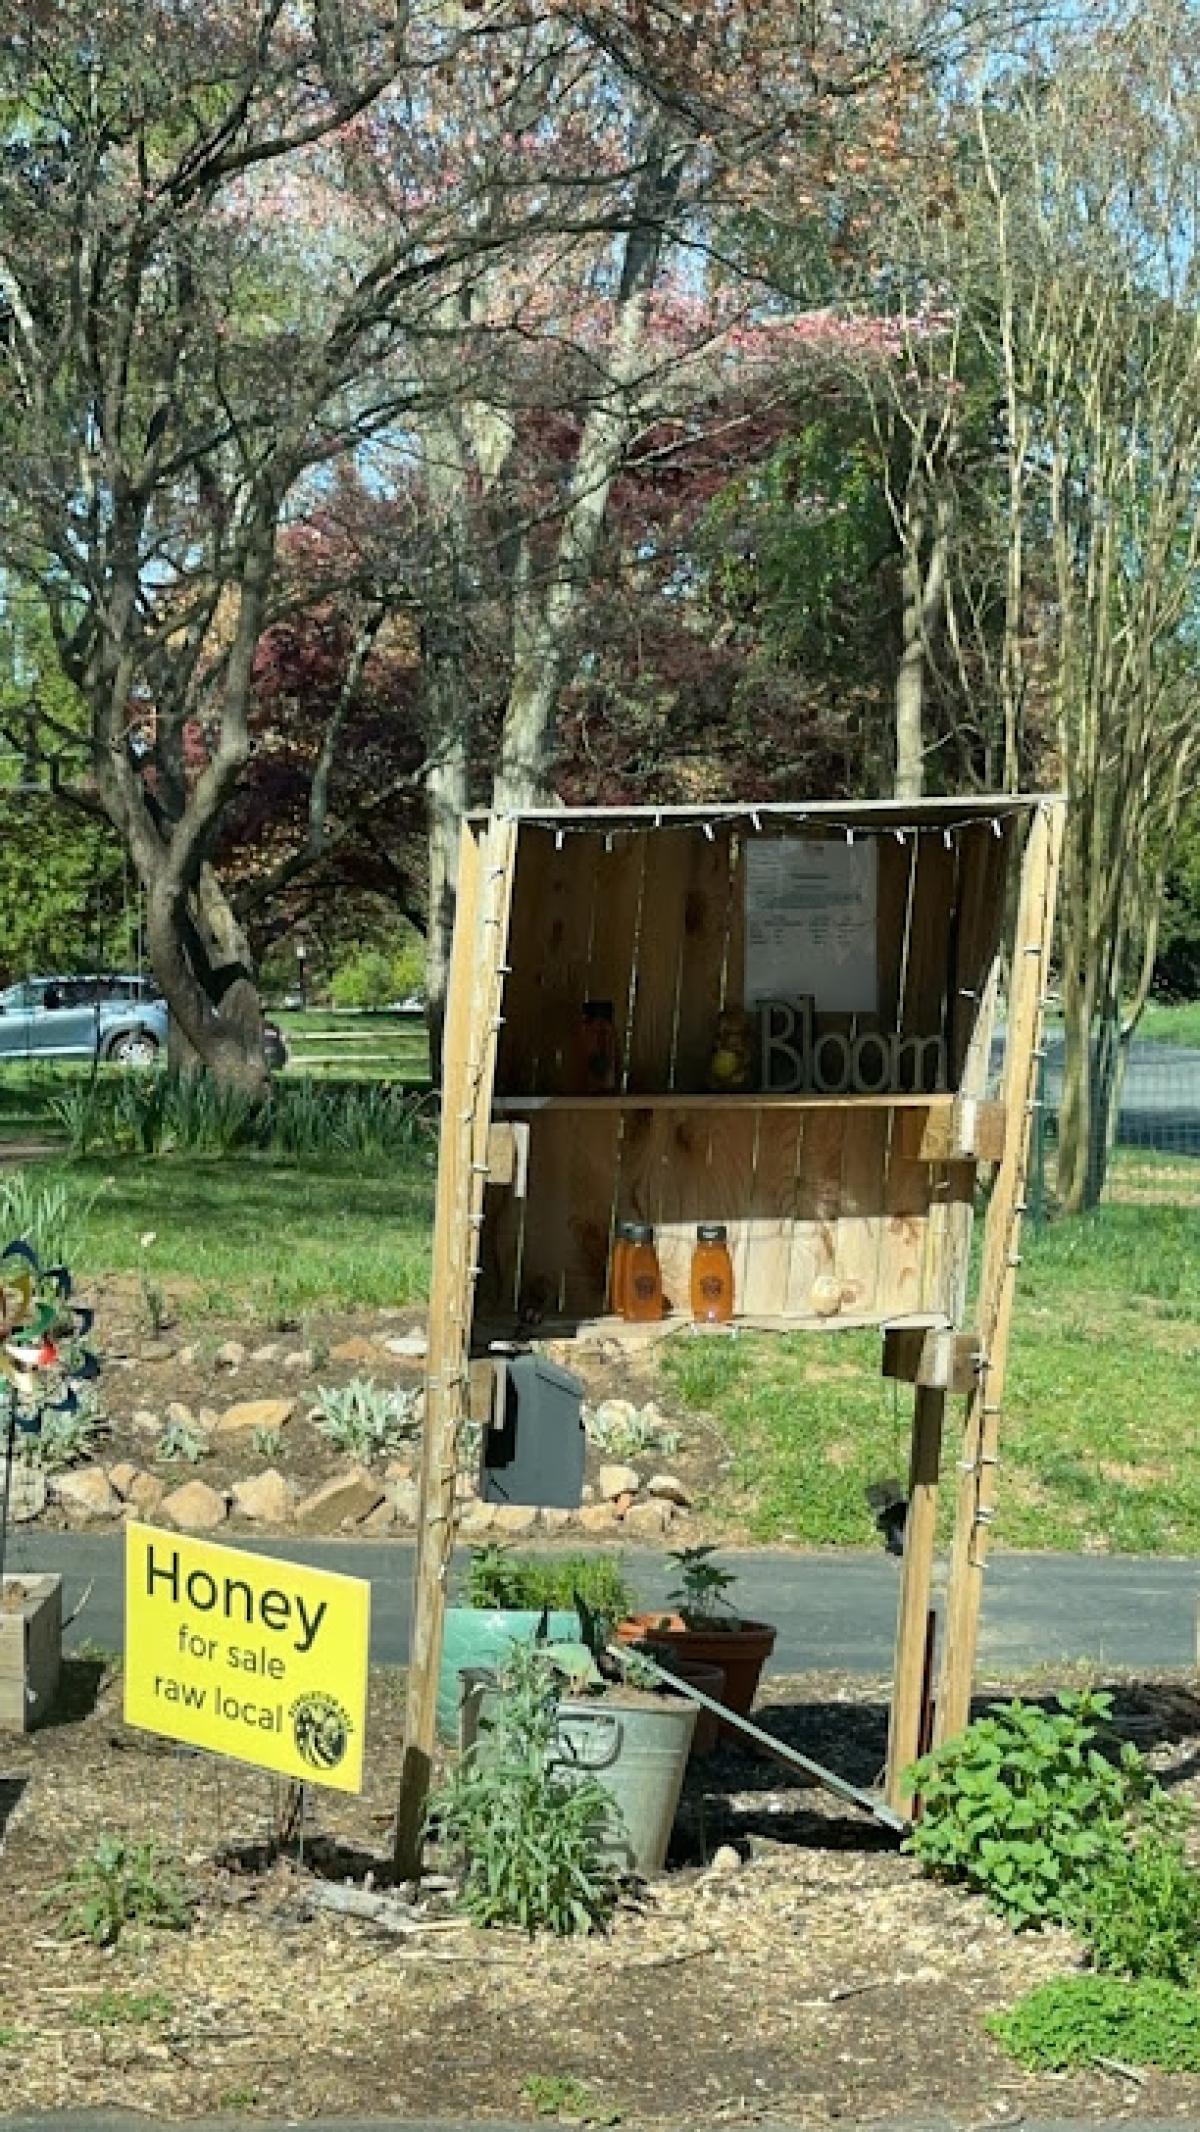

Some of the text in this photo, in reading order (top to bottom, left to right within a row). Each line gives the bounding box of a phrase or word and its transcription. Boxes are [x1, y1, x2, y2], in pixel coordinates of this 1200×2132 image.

[757, 994, 948, 1091] Bloom
[147, 1544, 328, 1653] Honey
[178, 1623, 286, 1679] for sale
[155, 1675, 207, 1709] raw
[214, 1687, 283, 1733] local
